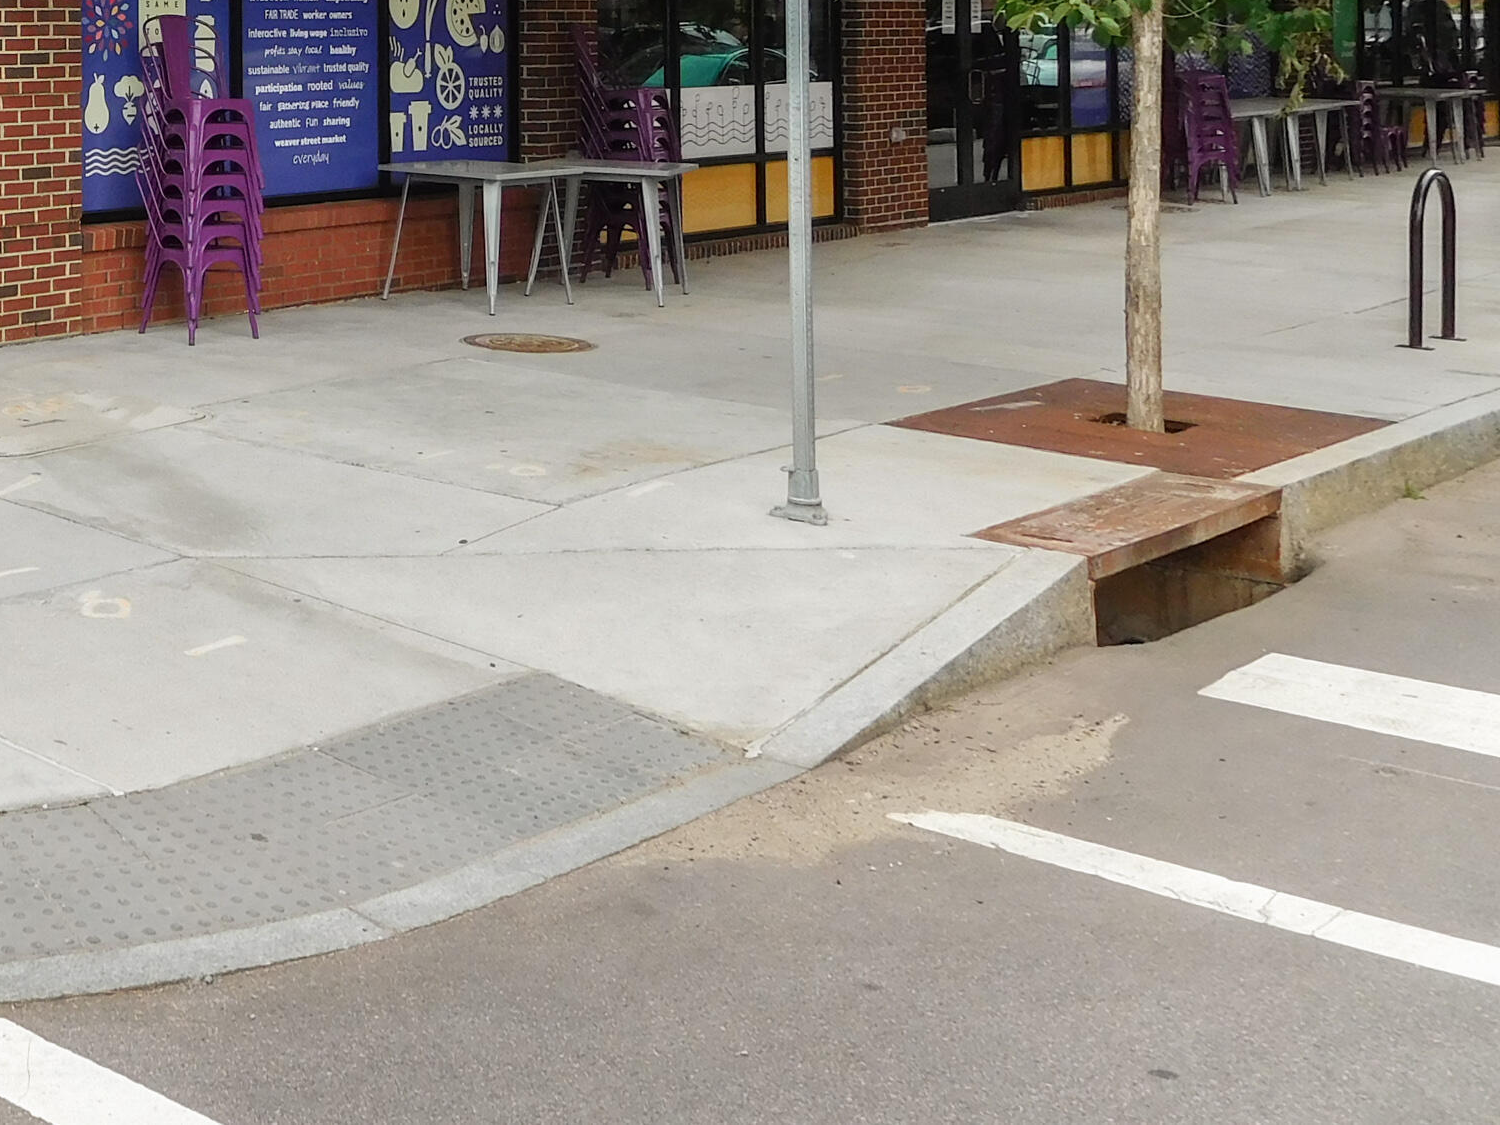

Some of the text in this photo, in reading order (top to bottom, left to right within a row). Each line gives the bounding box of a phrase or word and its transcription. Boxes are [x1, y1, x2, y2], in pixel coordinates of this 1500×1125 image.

[265, 9, 353, 19] FAIR TRADE worker owners
[330, 45, 356, 56] healthy
[248, 65, 290, 75] sustainable
[324, 63, 346, 72] trusted
[348, 62, 369, 73] quality
[255, 82, 302, 95] participation
[308, 80, 333, 91] rooted
[469, 77, 503, 87] TRUSTED
[469, 88, 503, 100] QUALITY
[260, 101, 272, 111] fair
[333, 97, 359, 109] friendly
[269, 116, 350, 129] authentic fun sharing
[469, 123, 504, 134] LOCALLY
[275, 135, 346, 147] weaver street market
[469, 136, 503, 147] SOURCED
[293, 150, 329, 165] everyday
